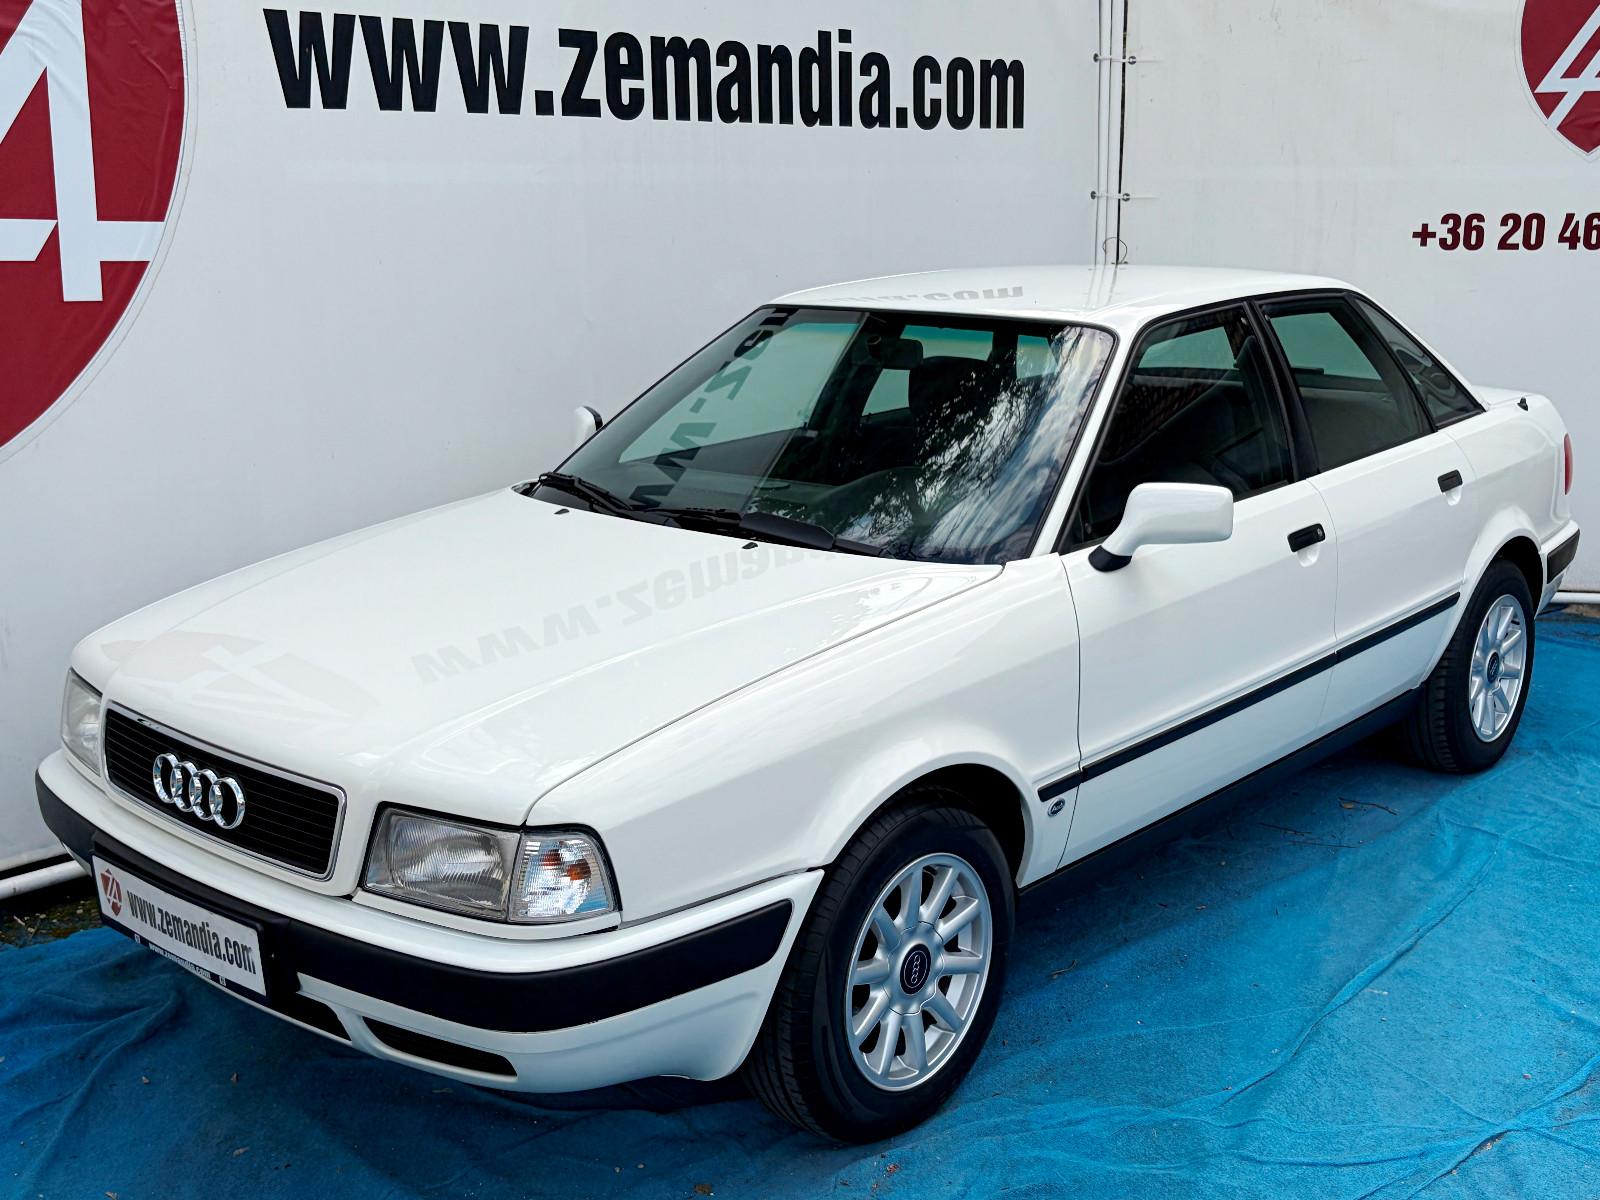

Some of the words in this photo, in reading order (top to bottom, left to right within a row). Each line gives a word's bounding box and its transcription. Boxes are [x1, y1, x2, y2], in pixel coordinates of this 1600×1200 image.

[263, 8, 1024, 131] www.zemandia.com
[1412, 213, 1486, 251] +36
[1498, 213, 1546, 251] 20
[1558, 212, 1600, 251] 46
[126, 889, 256, 976] www.zemandia.com
